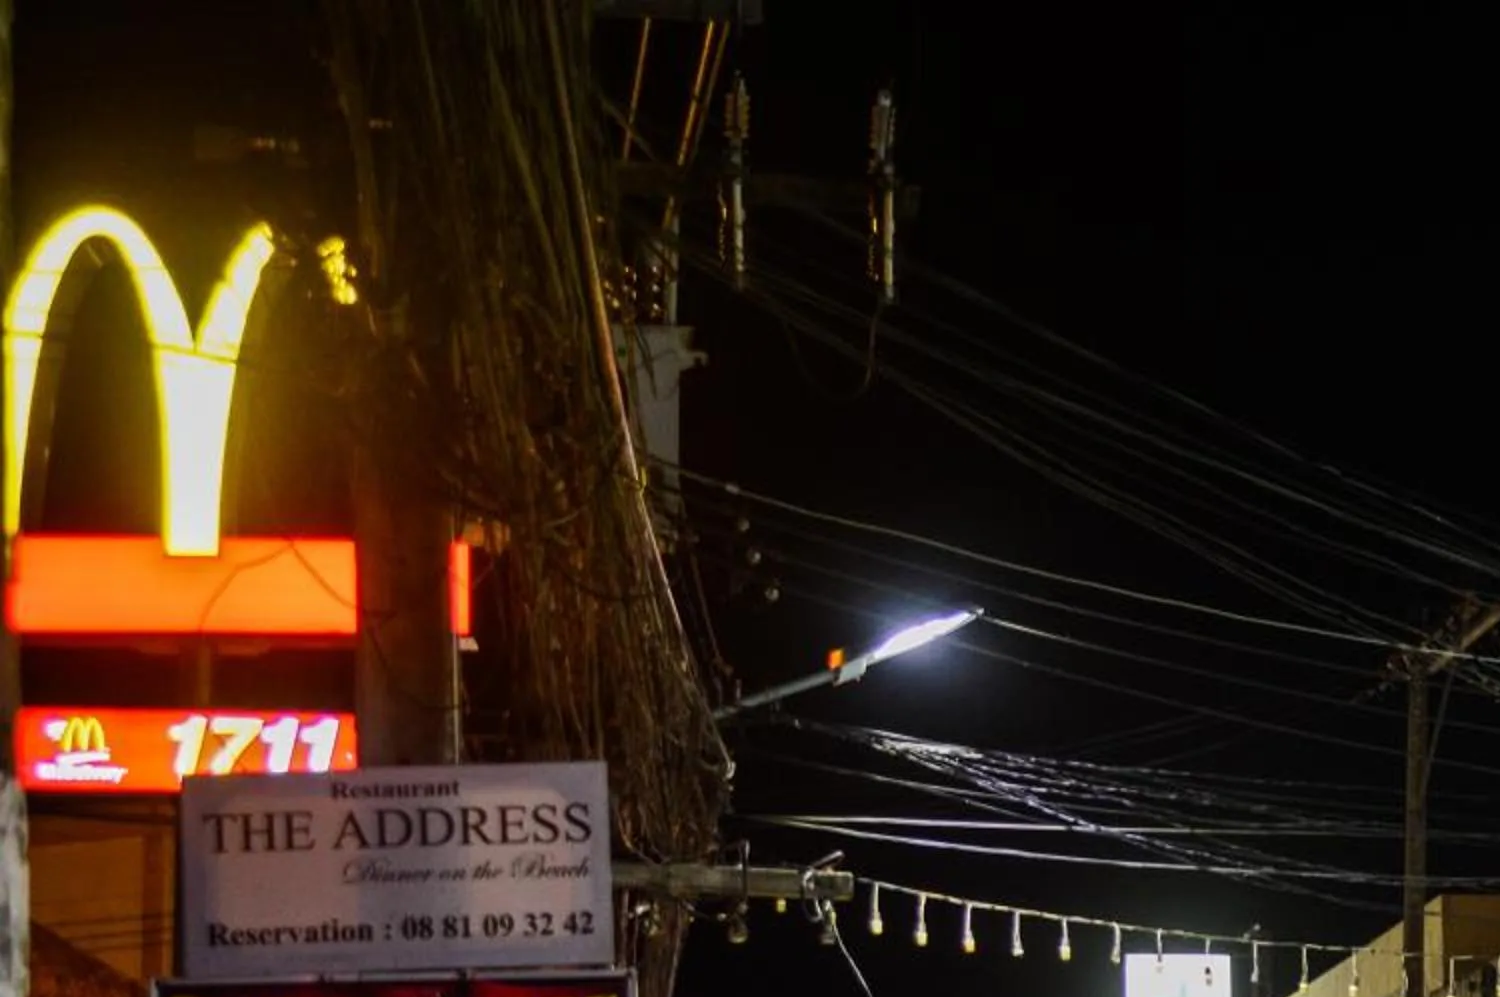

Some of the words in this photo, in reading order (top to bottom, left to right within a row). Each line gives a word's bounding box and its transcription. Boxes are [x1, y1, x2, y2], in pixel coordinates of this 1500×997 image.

[331, 779, 460, 801] Restaurant
[203, 810, 316, 855] THE
[332, 802, 593, 852] ADDRESS
[437, 867, 468, 883] on
[470, 860, 504, 881] the
[511, 853, 590, 880] Beach
[207, 917, 375, 948] Reservation
[400, 914, 435, 941] 08
[442, 913, 473, 940] 81
[482, 912, 515, 938] 09
[523, 911, 555, 937] 32
[563, 910, 595, 935] 42
